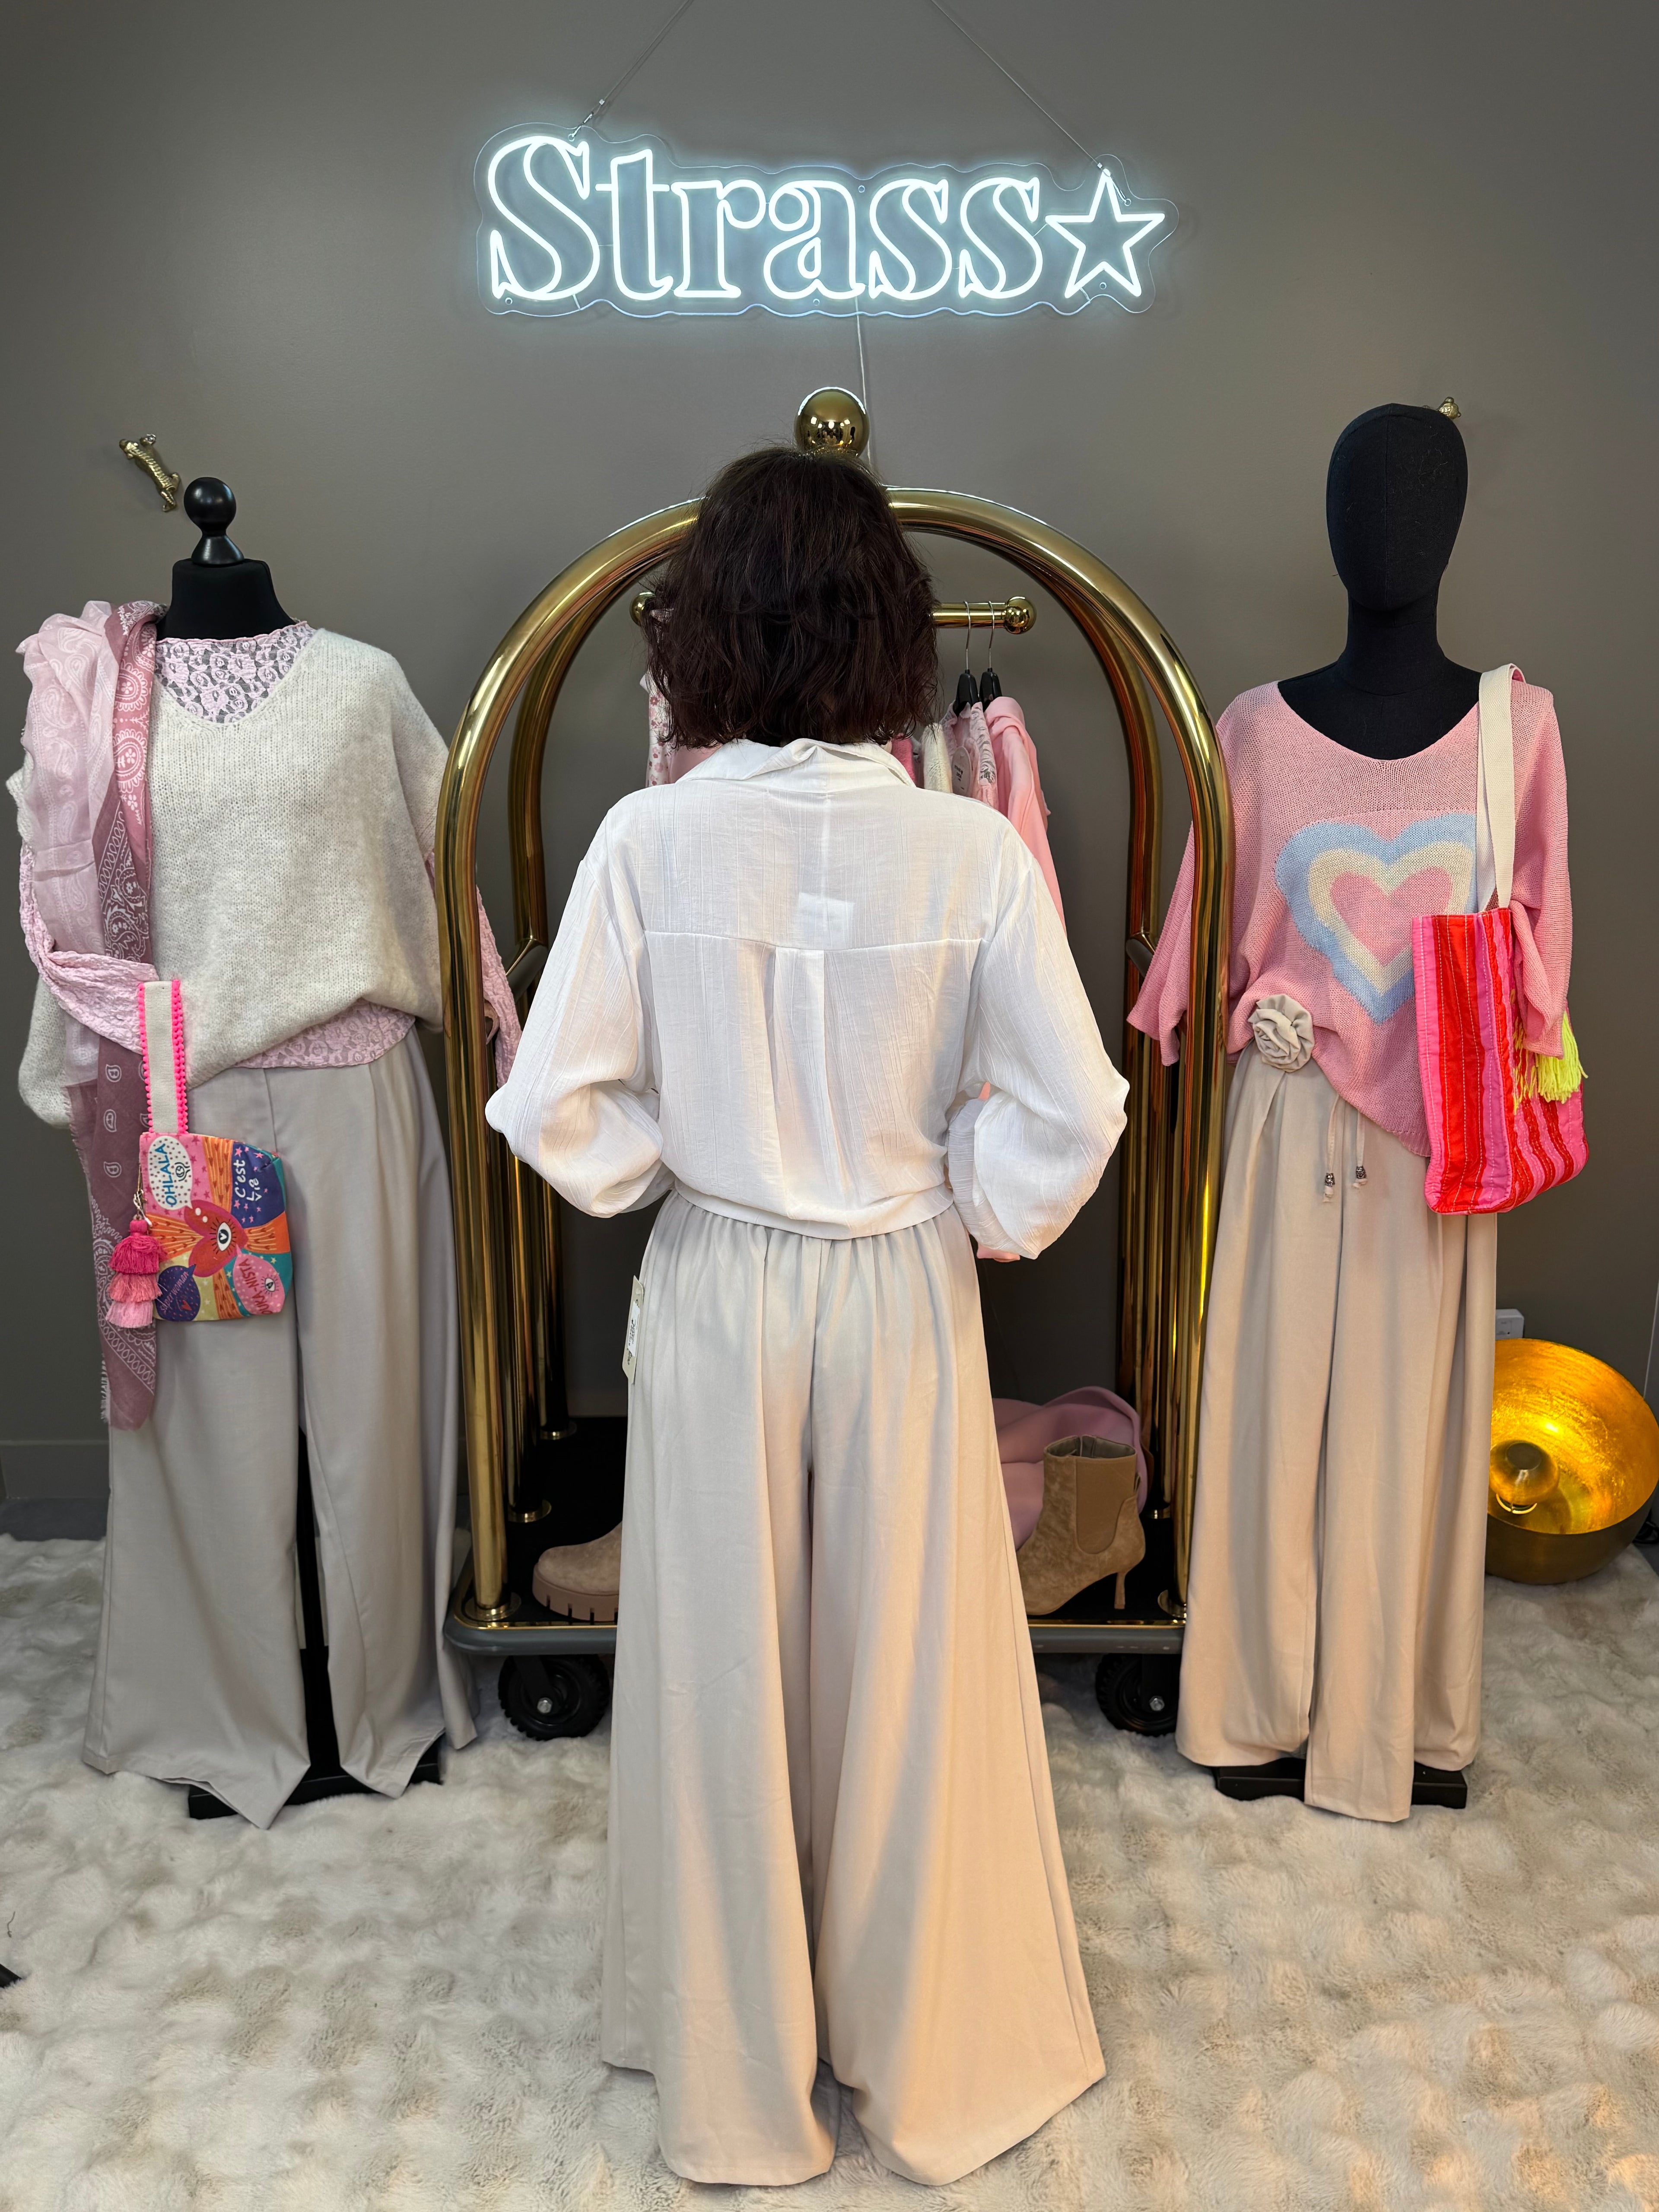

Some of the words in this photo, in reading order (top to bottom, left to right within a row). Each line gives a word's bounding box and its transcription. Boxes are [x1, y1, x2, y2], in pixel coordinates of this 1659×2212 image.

[486, 133, 1045, 302] Strass
[154, 1143, 178, 1207] OHLALA
[232, 1159, 247, 1198] C'est
[171, 1271, 189, 1295] woman
